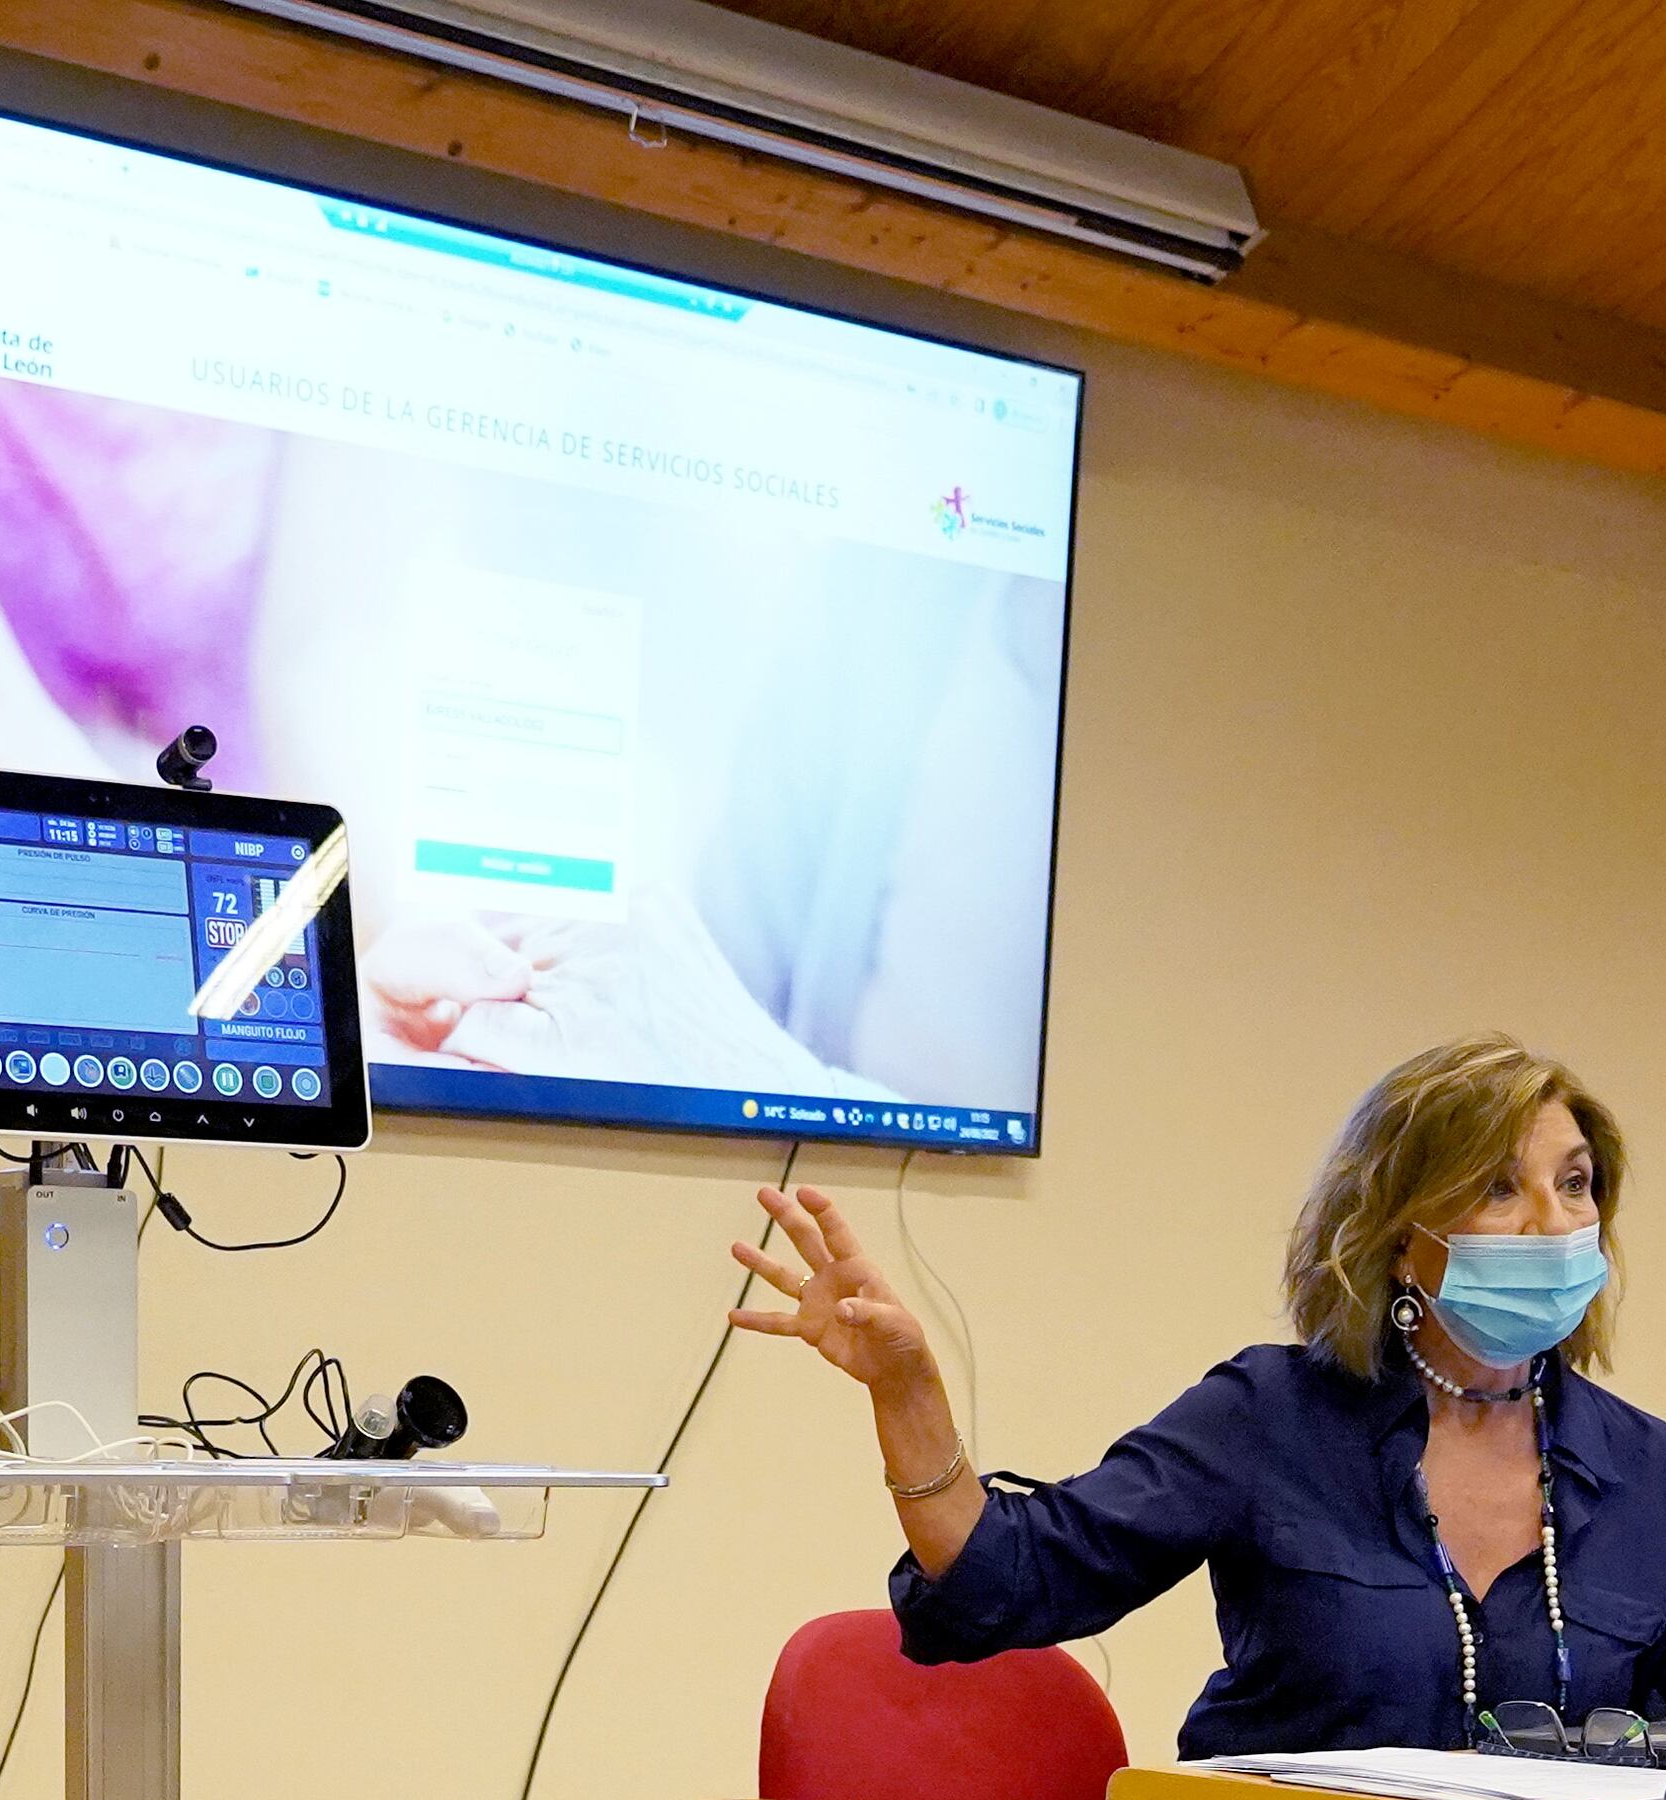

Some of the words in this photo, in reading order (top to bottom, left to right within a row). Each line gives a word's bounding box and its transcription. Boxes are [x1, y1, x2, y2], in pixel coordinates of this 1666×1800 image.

[28, 333, 54, 354] de
[3, 352, 53, 378] León
[191, 357, 331, 406] USUARIOS
[341, 386, 374, 416] DE
[386, 397, 415, 423] LA
[426, 404, 550, 451] GERENCIA
[561, 431, 591, 460] DE
[601, 440, 724, 486] SERVICIOS
[733, 466, 840, 508] SOCIALES
[49, 829, 79, 843] 11:15
[65, 852, 91, 863] PULSO
[234, 841, 265, 857] NIBP
[212, 892, 239, 915] 72
[208, 922, 246, 946] STOP
[221, 1023, 273, 1038] MANGUITO
[275, 1027, 306, 1041] FLOJO
[36, 1190, 54, 1198] OUT
